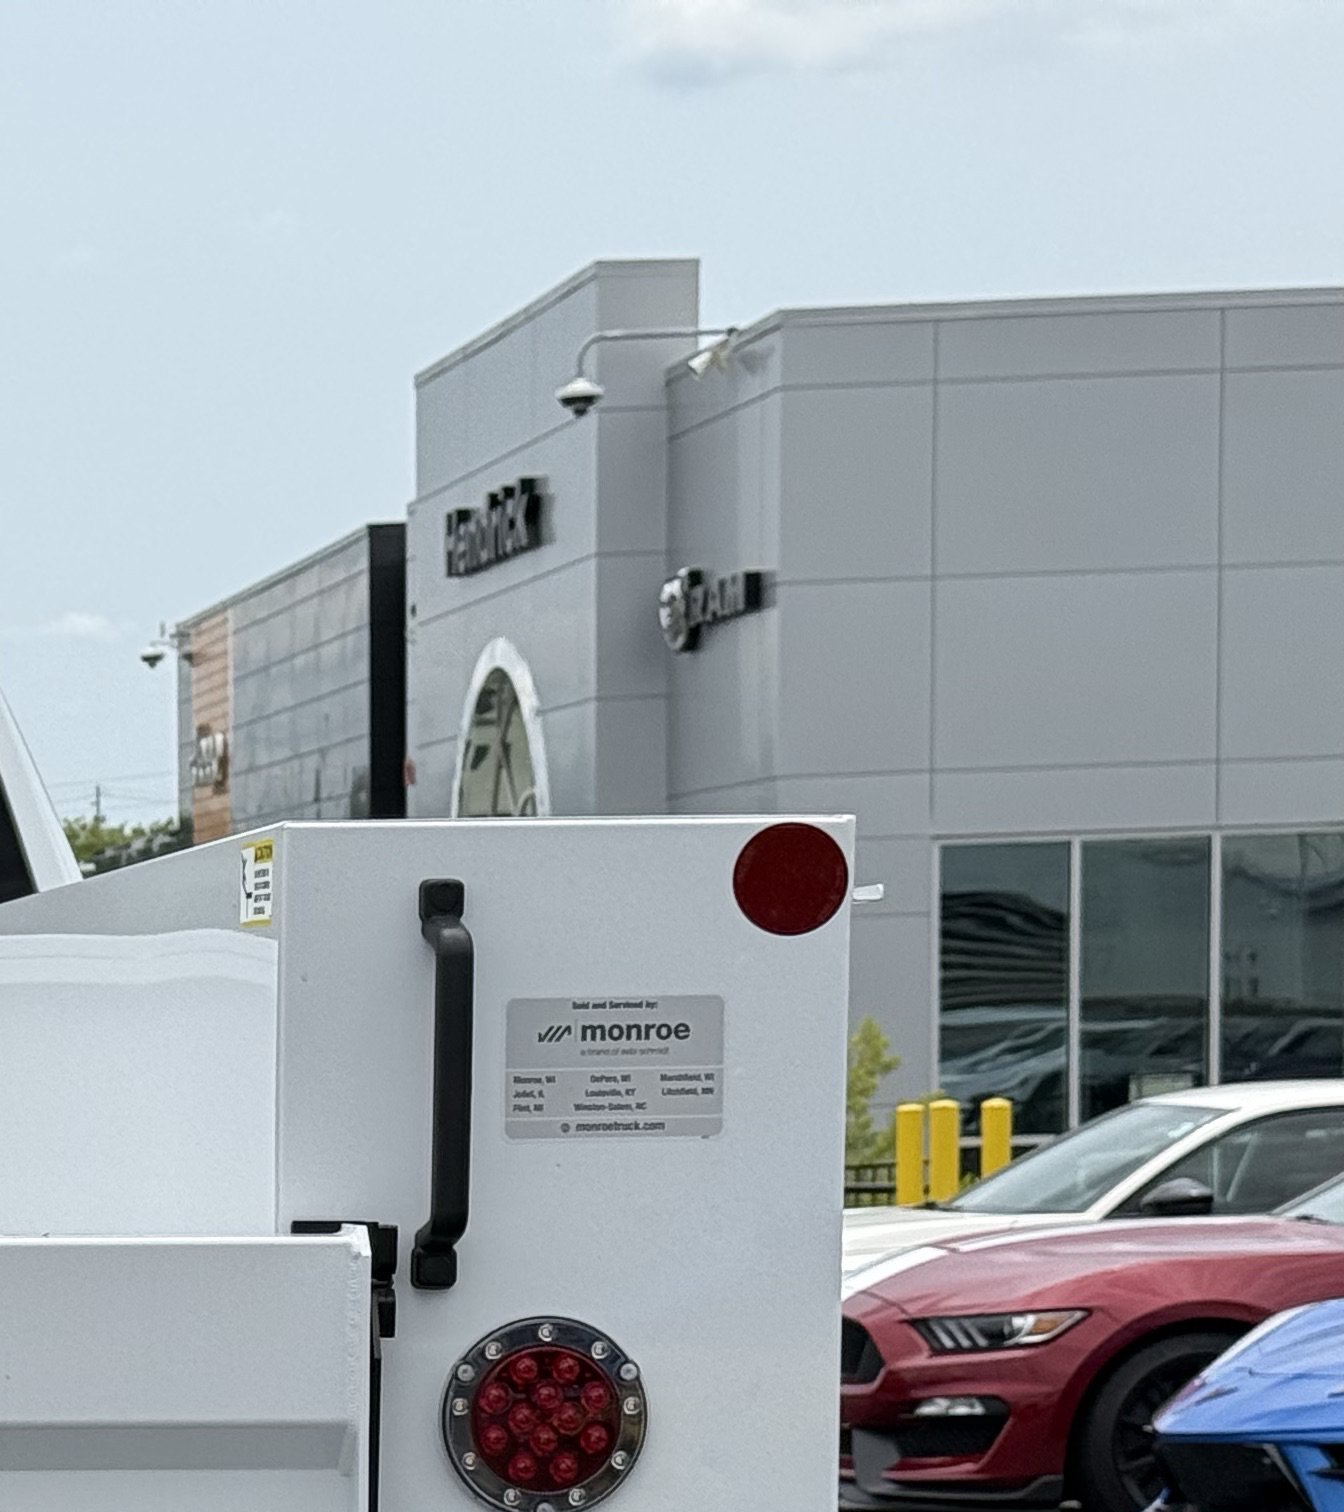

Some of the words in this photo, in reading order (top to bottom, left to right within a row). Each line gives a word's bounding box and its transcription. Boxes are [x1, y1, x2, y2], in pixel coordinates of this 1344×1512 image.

[446, 477, 541, 578] Hendrick
[580, 1022, 691, 1042] monroe
[575, 1121, 666, 1133] monroetruck.com
